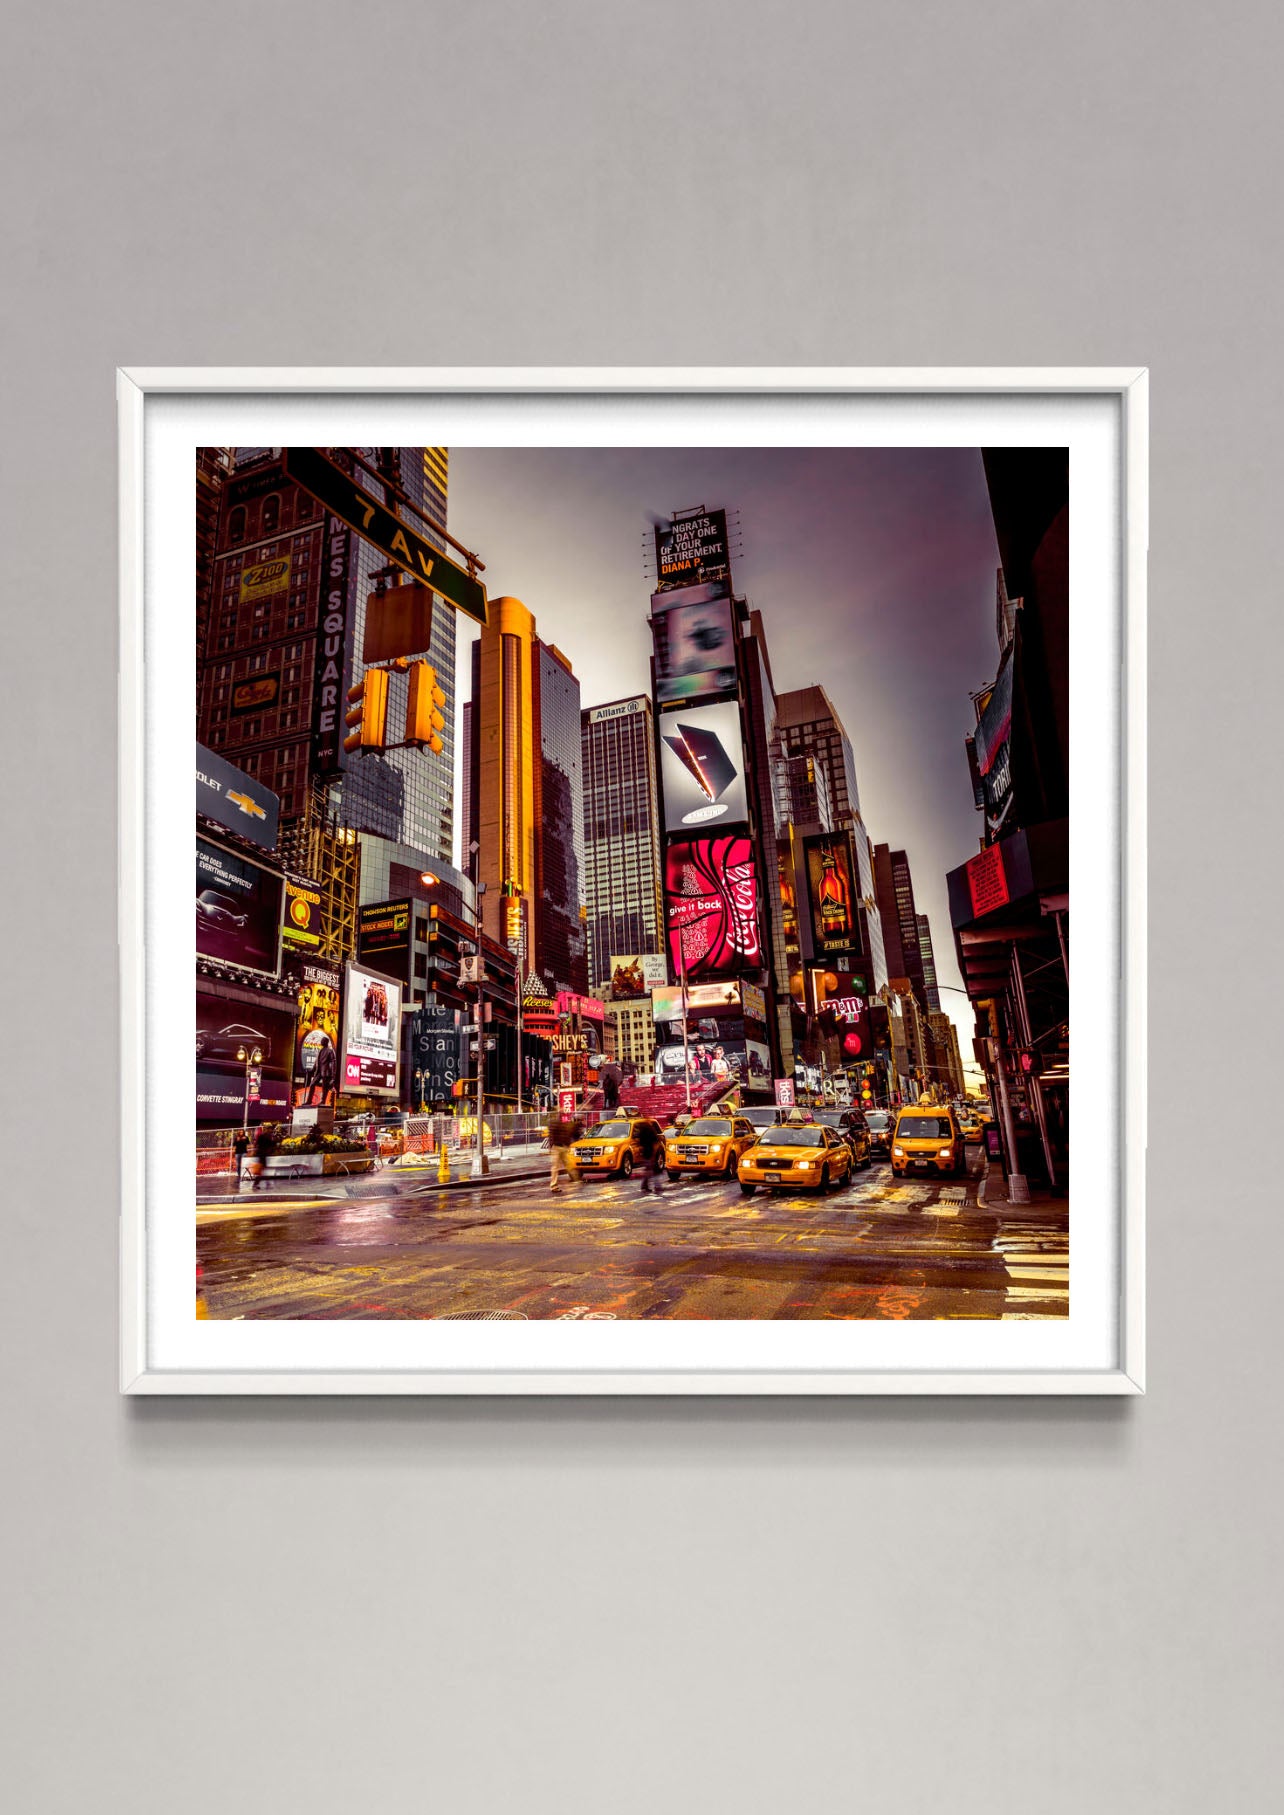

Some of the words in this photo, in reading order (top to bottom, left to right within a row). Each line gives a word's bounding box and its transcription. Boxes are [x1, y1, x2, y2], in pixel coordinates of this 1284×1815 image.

[354, 493, 376, 530] 7
[390, 529, 434, 577] AV
[672, 517, 710, 535] NGRATS
[676, 530, 695, 543] DAY
[697, 525, 718, 538] ONE
[661, 542, 723, 565] RETIREMENT
[674, 538, 701, 552] YOUR
[248, 563, 284, 585] Z100
[661, 559, 692, 575] DIANA
[693, 557, 704, 568] P.
[319, 590, 344, 733] SQUARE
[596, 706, 627, 720] Allianz
[317, 748, 334, 758] NYC
[199, 860, 229, 879] EVERYTHING
[228, 873, 253, 890] PERFECTLY
[286, 880, 320, 904] Avenue
[290, 896, 311, 930] Q
[669, 905, 687, 917] give
[688, 903, 695, 911] it
[697, 900, 722, 911] back
[507, 906, 524, 960] RSHEY'S
[304, 966, 316, 978] THE
[316, 970, 340, 984] BIGGEST
[196, 1094, 222, 1104] CORVETTE
[221, 1096, 244, 1104] STINGRAY
[780, 1081, 791, 1104] tkts
[563, 1094, 573, 1114] tkts
